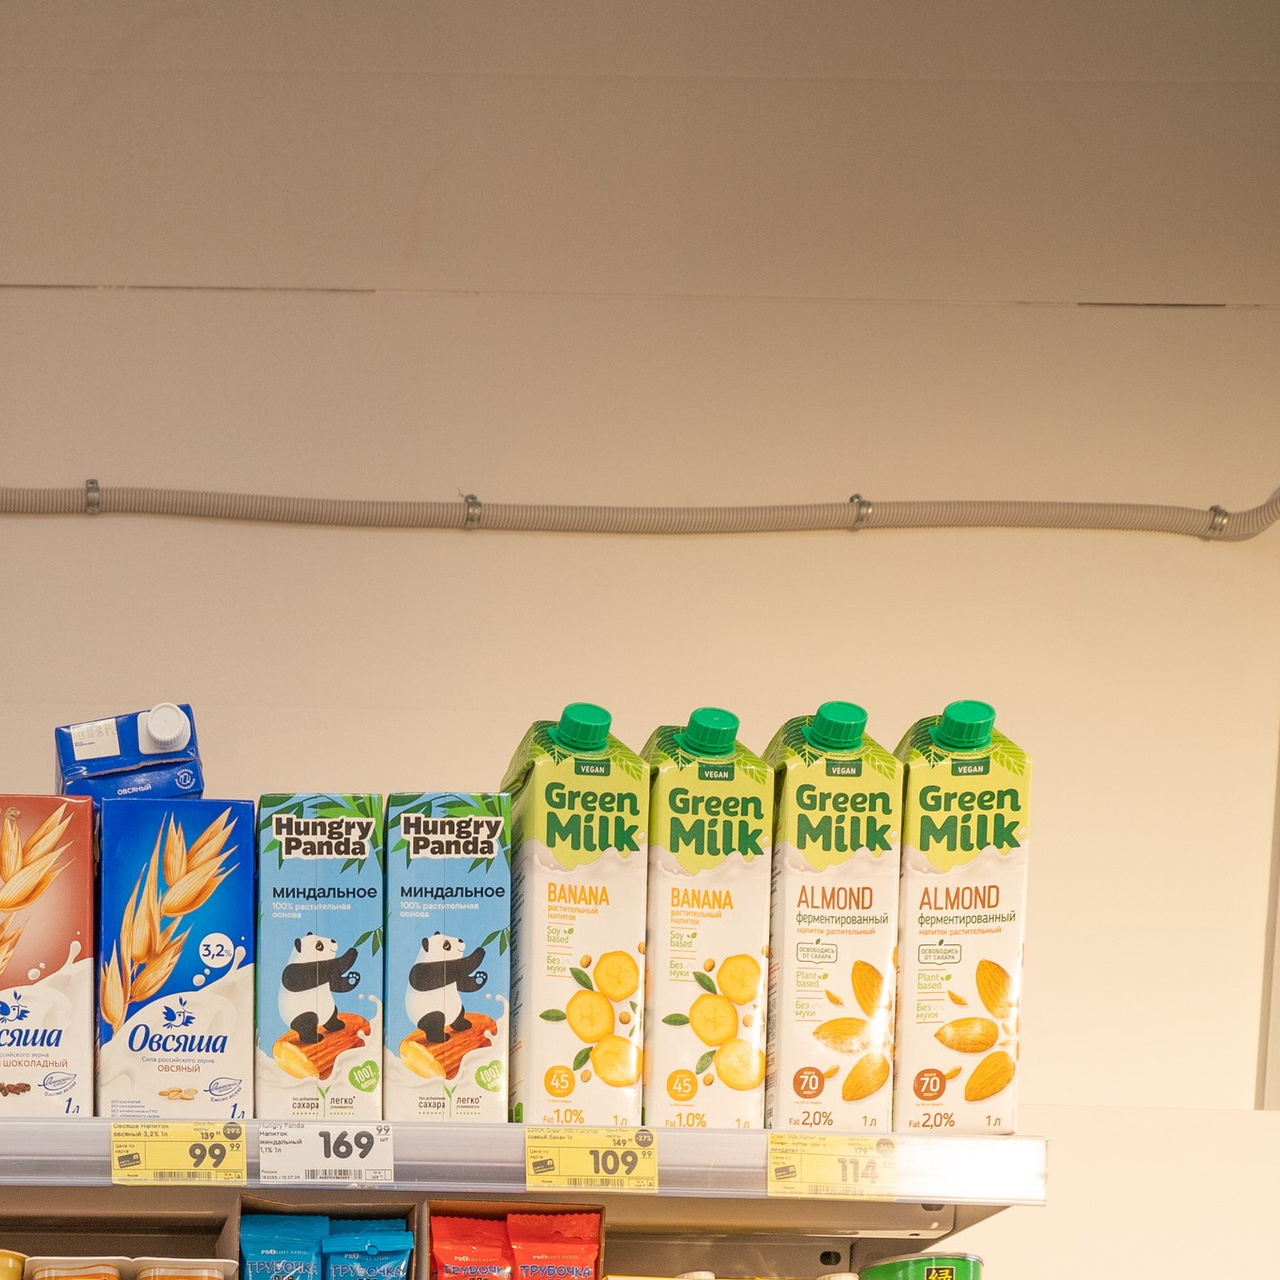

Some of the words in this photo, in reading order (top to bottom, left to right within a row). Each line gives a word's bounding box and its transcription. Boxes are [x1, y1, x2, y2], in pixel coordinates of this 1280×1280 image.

[581, 766, 604, 774] VEGAN
[545, 782, 639, 816] Green
[275, 816, 373, 841] Hungry
[546, 814, 640, 851] Milk
[284, 837, 366, 856] Panda
[272, 885, 377, 900] миндальное
[547, 882, 609, 906] BANANA
[920, 885, 999, 910] ALMOND
[918, 911, 1015, 927] ферментированный
[202, 943, 232, 958] 3,2%
[551, 1074, 568, 1088] 45
[319, 1130, 373, 1158] 169
[590, 1150, 637, 1175] 109
